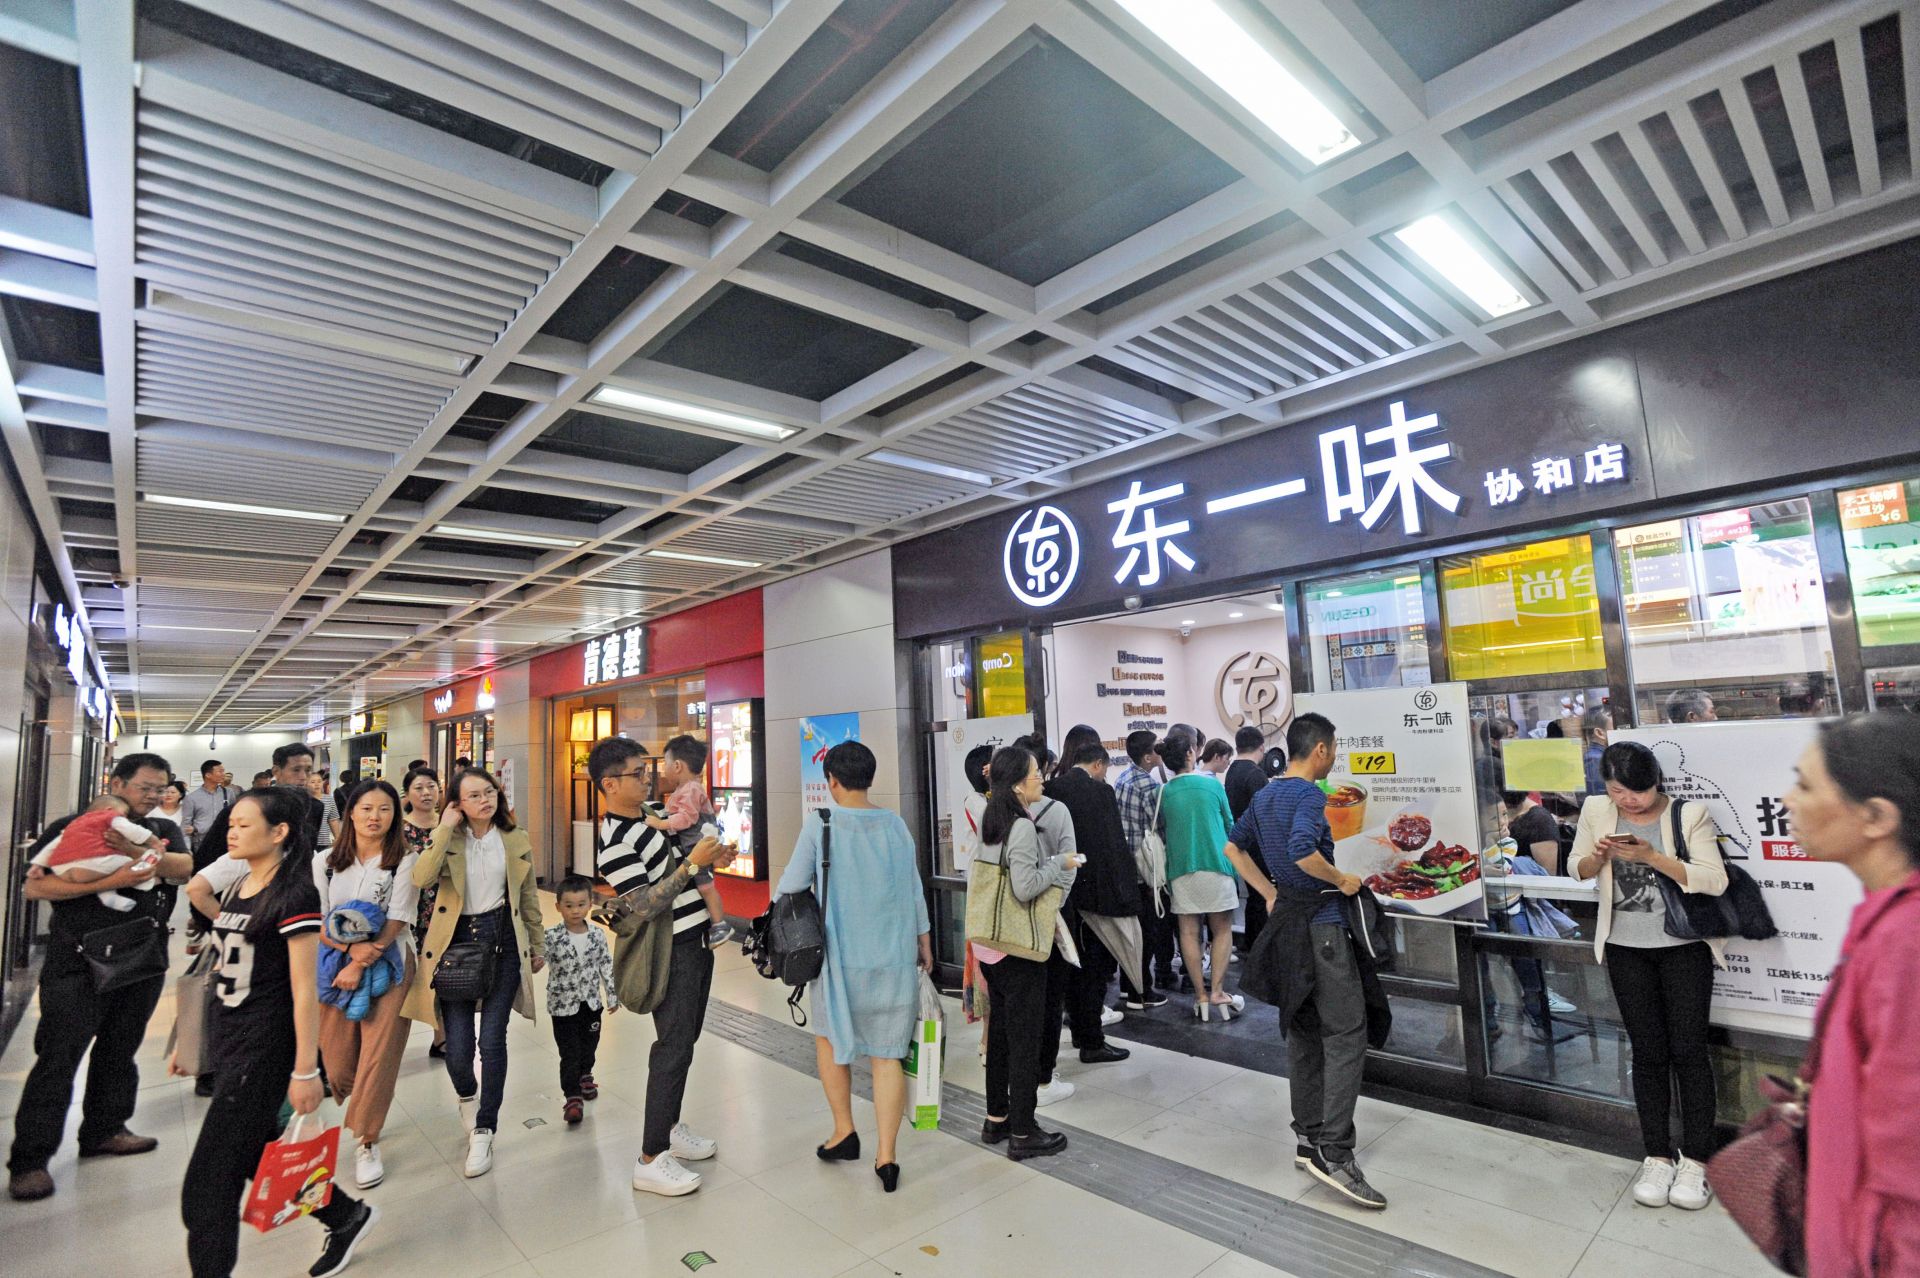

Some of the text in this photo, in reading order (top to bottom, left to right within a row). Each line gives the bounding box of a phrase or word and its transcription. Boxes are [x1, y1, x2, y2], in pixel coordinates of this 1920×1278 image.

[1107, 401, 1624, 586] 东一味 协和店
[584, 625, 643, 686] 肯德基
[1403, 711, 1453, 727] 东一味
[1357, 755, 1387, 771] ¥19
